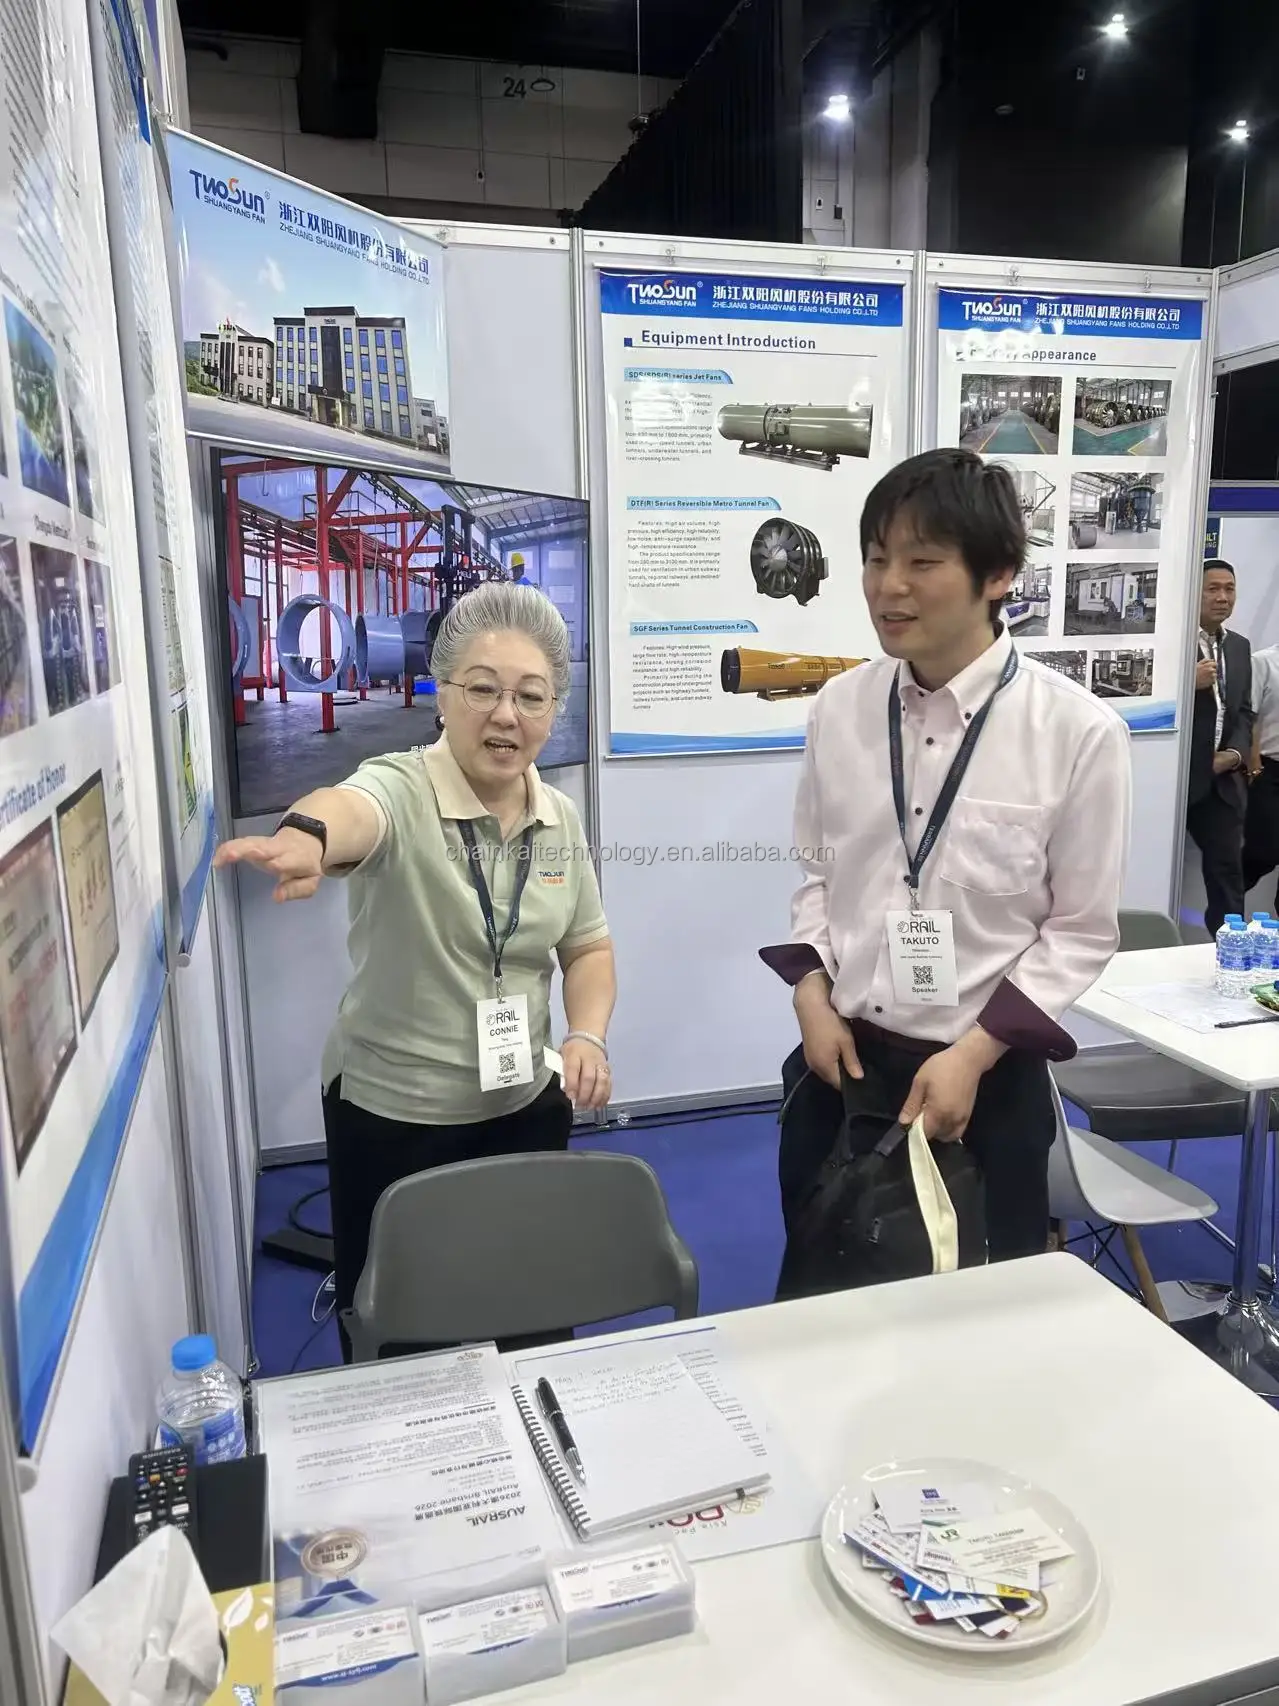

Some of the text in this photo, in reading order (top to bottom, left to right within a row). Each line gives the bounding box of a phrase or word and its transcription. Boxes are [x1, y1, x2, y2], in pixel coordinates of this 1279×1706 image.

[503, 77, 526, 98] 24
[203, 195, 266, 224] SHUANGYANG FAN
[280, 222, 314, 242] ZHEJIANG
[315, 236, 360, 259] SHUANGYANG
[380, 261, 407, 277] HOLDING
[639, 298, 683, 307] SHUANGYANG
[712, 285, 879, 308] 浙江双阳风机股份有限公司
[712, 301, 748, 310] ZHEJIANG
[749, 303, 797, 312] SHUANGYANG
[798, 305, 818, 313] FANS
[820, 307, 851, 315] HOLDING
[1035, 302, 1181, 322] 浙江双阳风机股份有限公司
[971, 315, 1009, 323] SHUANGYANG
[1066, 318, 1108, 327] SHUANGYANG
[1109, 320, 1126, 328] FANS
[1128, 321, 1155, 329] HOLDING
[641, 330, 816, 350] Equipment Introduction
[693, 623, 735, 631] Construction
[900, 936, 940, 945] TAKUTO
[489, 1024, 519, 1037] CONNIE
[496, 1072, 520, 1082] Delegate
[414, 1483, 519, 1511] AusRAIL Brisbane 2026
[466, 1505, 526, 1527] AUSRAIL
